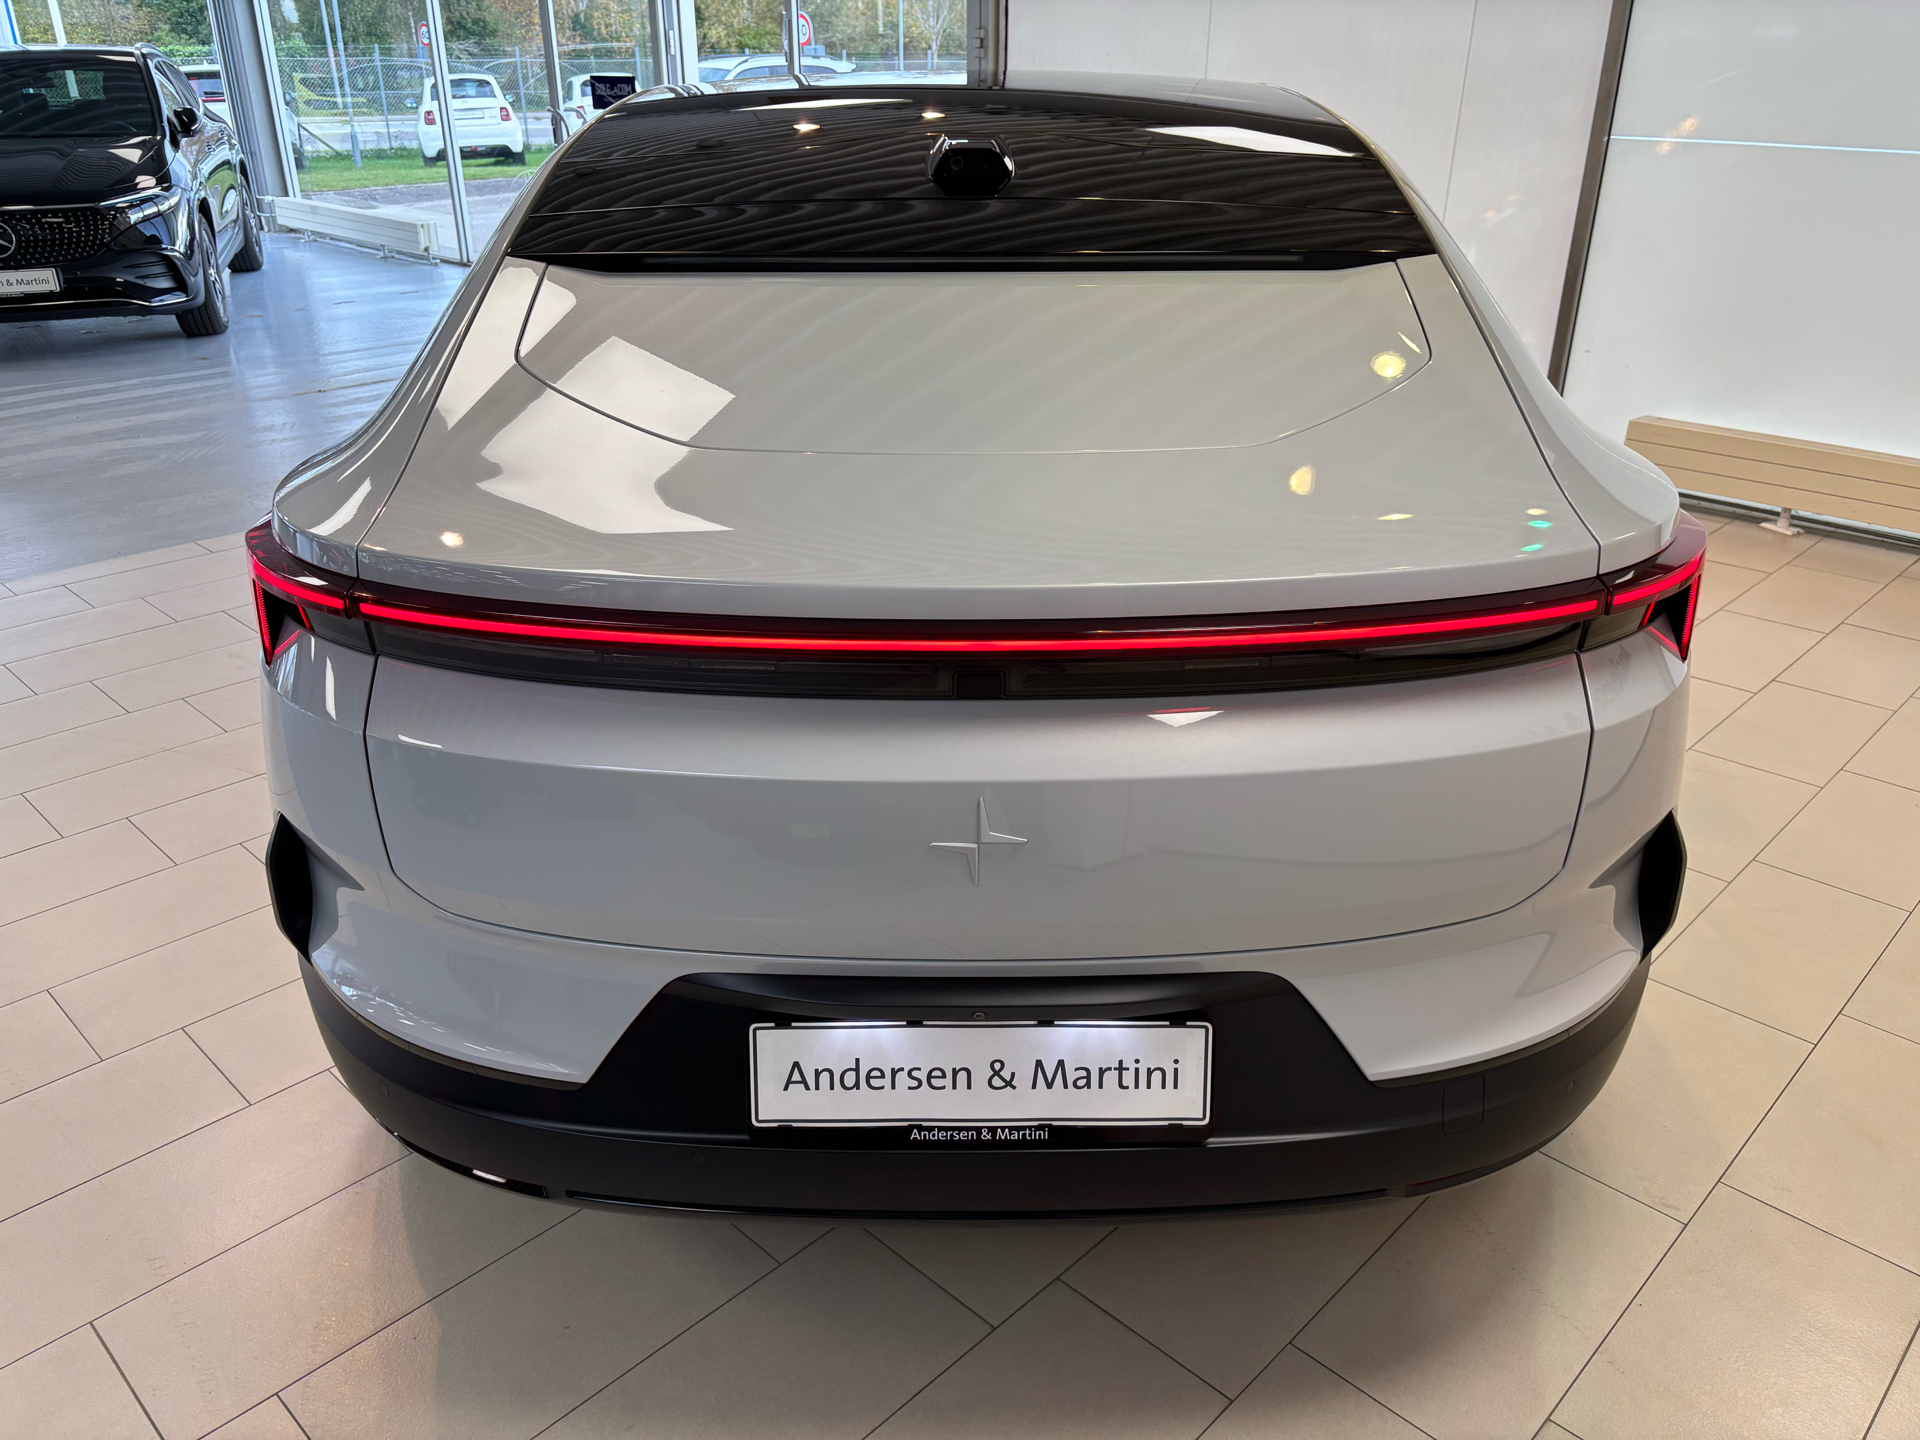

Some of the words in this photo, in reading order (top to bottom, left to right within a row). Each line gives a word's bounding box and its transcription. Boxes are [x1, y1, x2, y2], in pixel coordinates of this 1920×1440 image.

[5, 278, 14, 287] &
[15, 276, 50, 287] Martini
[782, 1057, 972, 1091] Andersen
[987, 1058, 1017, 1091] &
[1031, 1058, 1180, 1090] Martini
[910, 1127, 977, 1141] Andersen
[981, 1128, 992, 1140] &
[996, 1127, 1049, 1141] Martini
